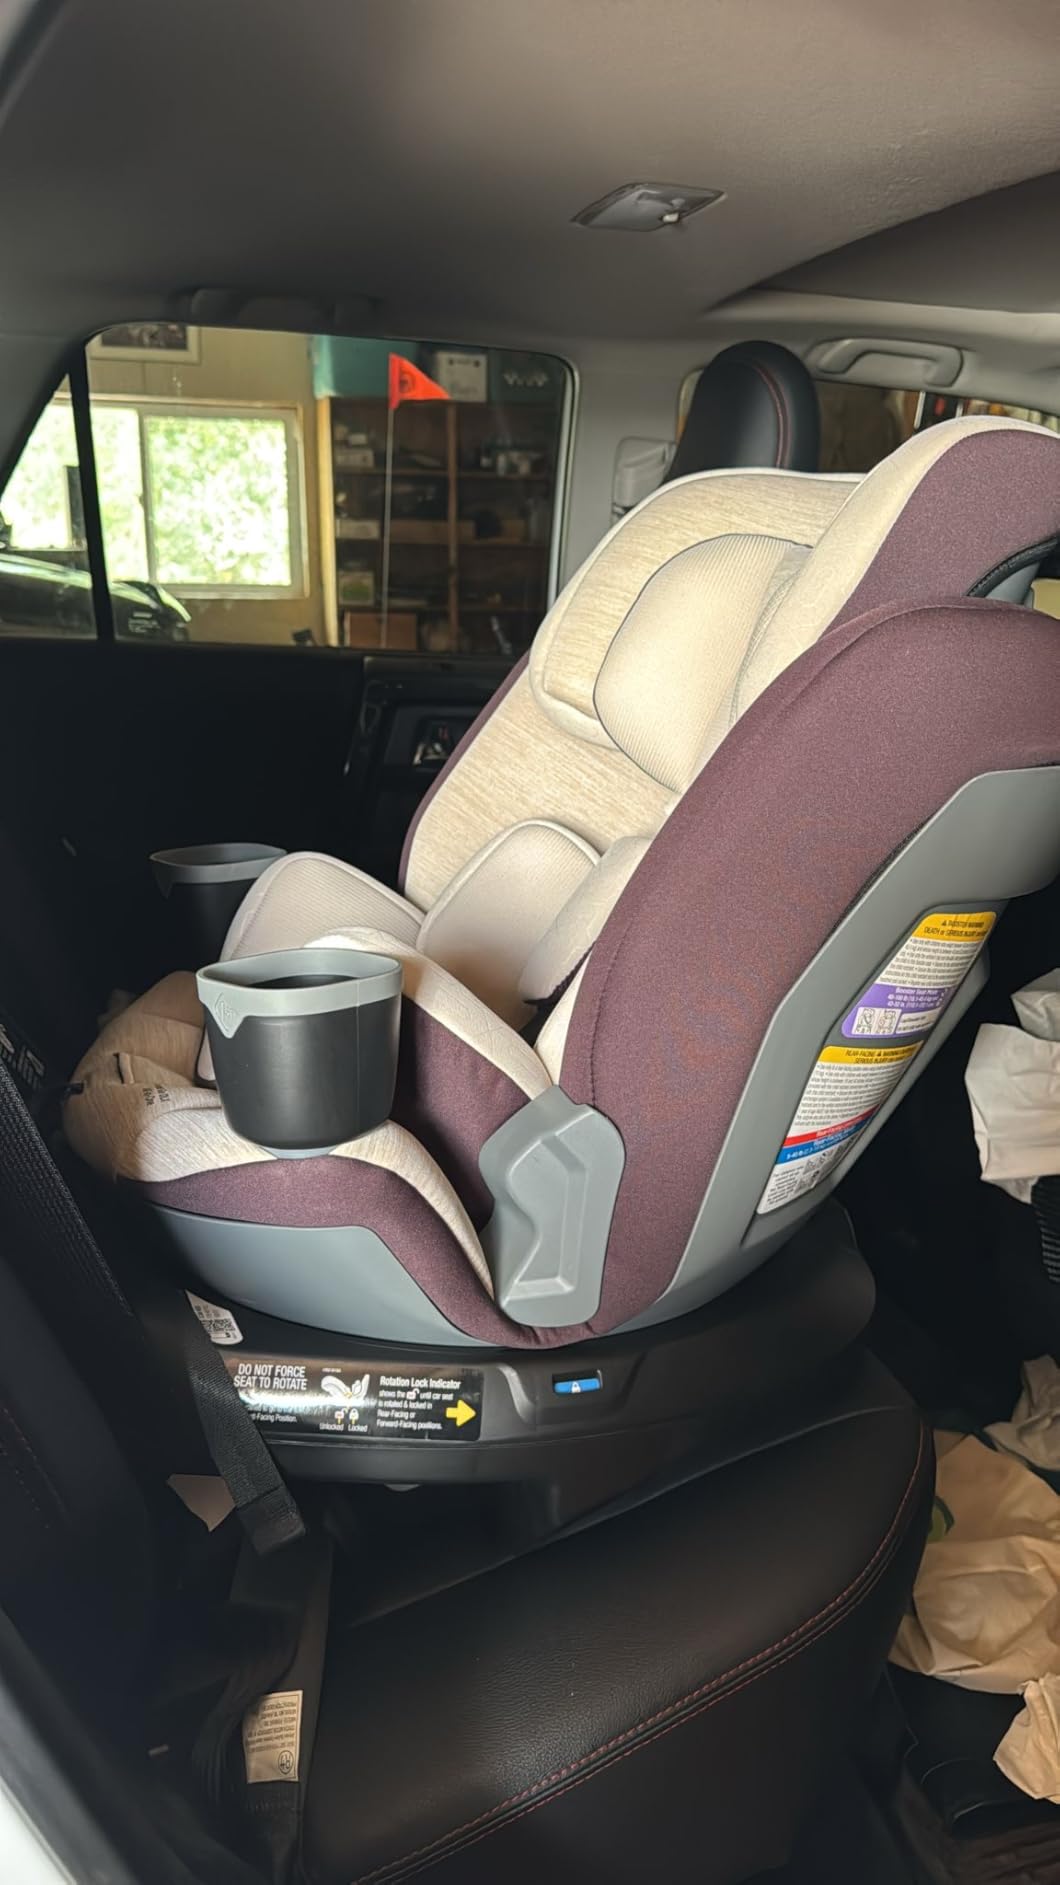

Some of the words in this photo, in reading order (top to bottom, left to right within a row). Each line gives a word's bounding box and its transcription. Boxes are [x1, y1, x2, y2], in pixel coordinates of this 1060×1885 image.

[238, 1363, 252, 1375] DO
[254, 1364, 274, 1376] NOT
[274, 1365, 306, 1378] FORCE
[233, 1376, 256, 1388] SEAT
[260, 1377, 271, 1389] TO
[272, 1378, 308, 1390] ROTATE
[380, 1375, 409, 1387] Rotation
[411, 1376, 428, 1388] Lock
[429, 1378, 461, 1389] Indicator
[379, 1389, 396, 1398] shows
[397, 1390, 406, 1398] the
[420, 1391, 431, 1400] until
[432, 1392, 442, 1400] car
[442, 1393, 454, 1401] seat
[384, 1400, 403, 1408] rotated
[404, 1401, 409, 1409] &
[409, 1401, 427, 1409] locked
[427, 1402, 433, 1410] in
[377, 1409, 409, 1420] Rear-Facing
[409, 1411, 416, 1419] or
[319, 1423, 344, 1431] Unlocked
[348, 1423, 368, 1432] Locked
[376, 1420, 417, 1430] Forward-Facing
[418, 1421, 443, 1430] positions.
